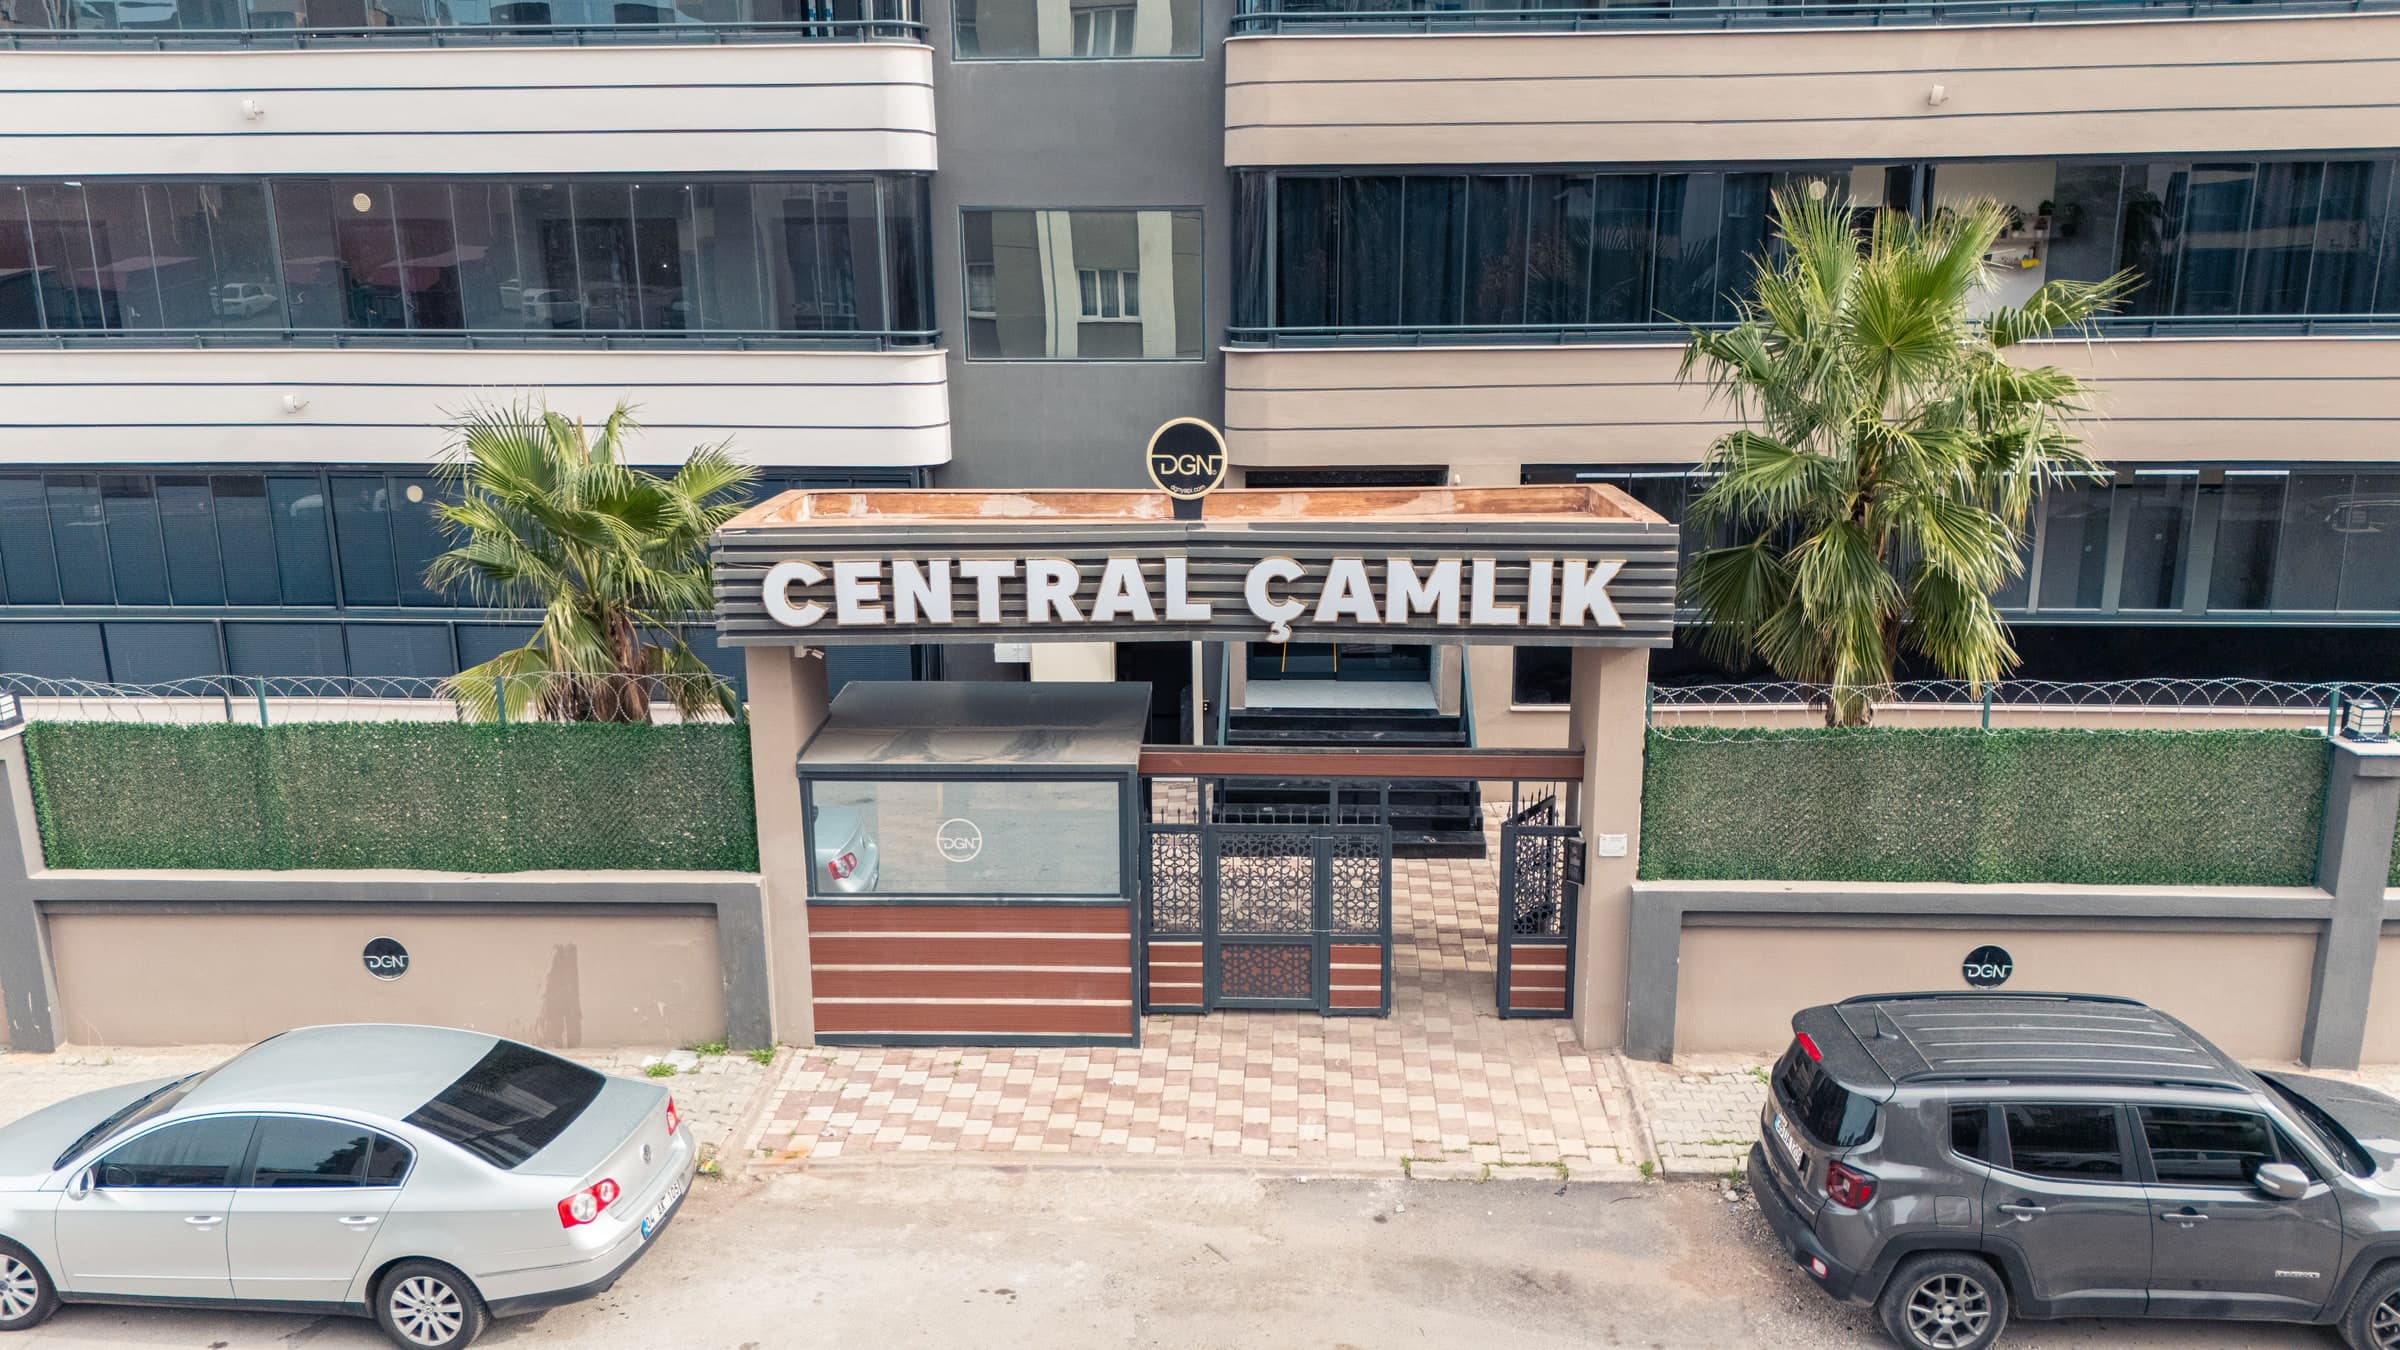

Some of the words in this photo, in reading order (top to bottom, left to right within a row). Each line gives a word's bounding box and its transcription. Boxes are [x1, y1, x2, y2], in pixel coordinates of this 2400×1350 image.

[1152, 454, 1220, 475] DGN
[763, 555, 1212, 627] CENTRAL
[1244, 556, 1627, 644] ÇAMLIK
[942, 837, 979, 849] DGN
[365, 955, 408, 968] DGN
[1965, 963, 2011, 978] DGN
